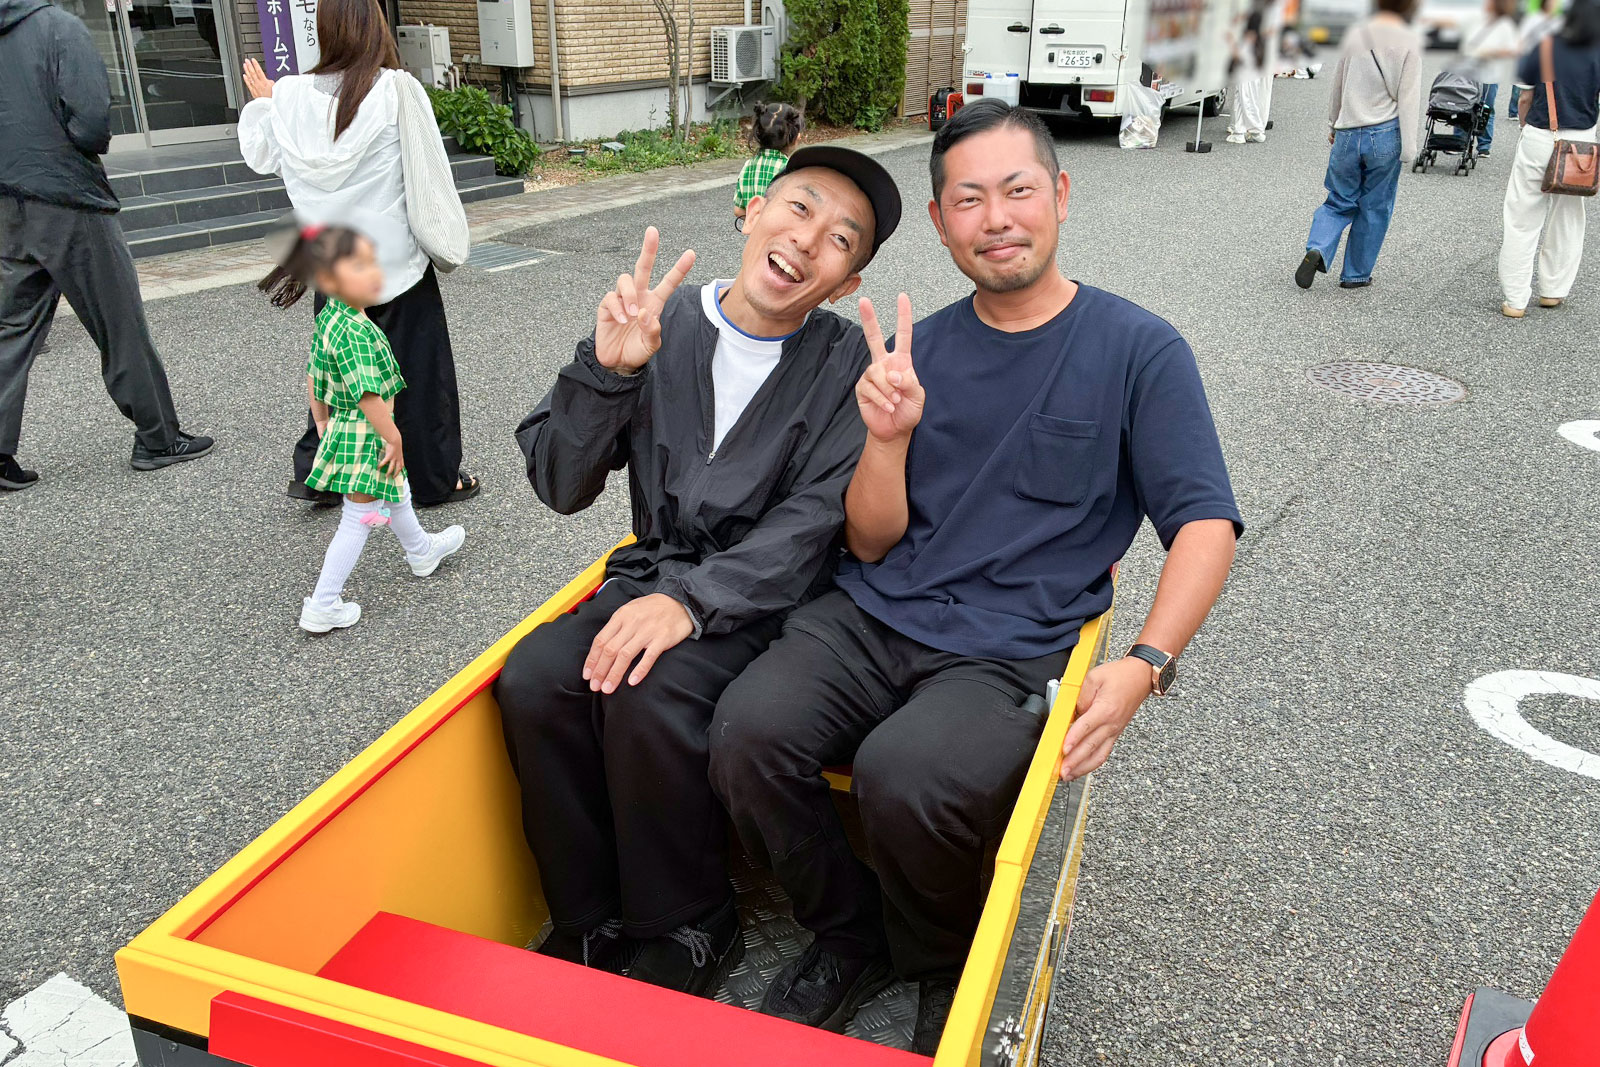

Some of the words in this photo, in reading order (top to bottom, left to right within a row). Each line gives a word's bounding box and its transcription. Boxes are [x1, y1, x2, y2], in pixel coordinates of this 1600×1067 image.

[267, 0, 290, 72] ホームズ
[1065, 56, 1090, 65] 26-55
